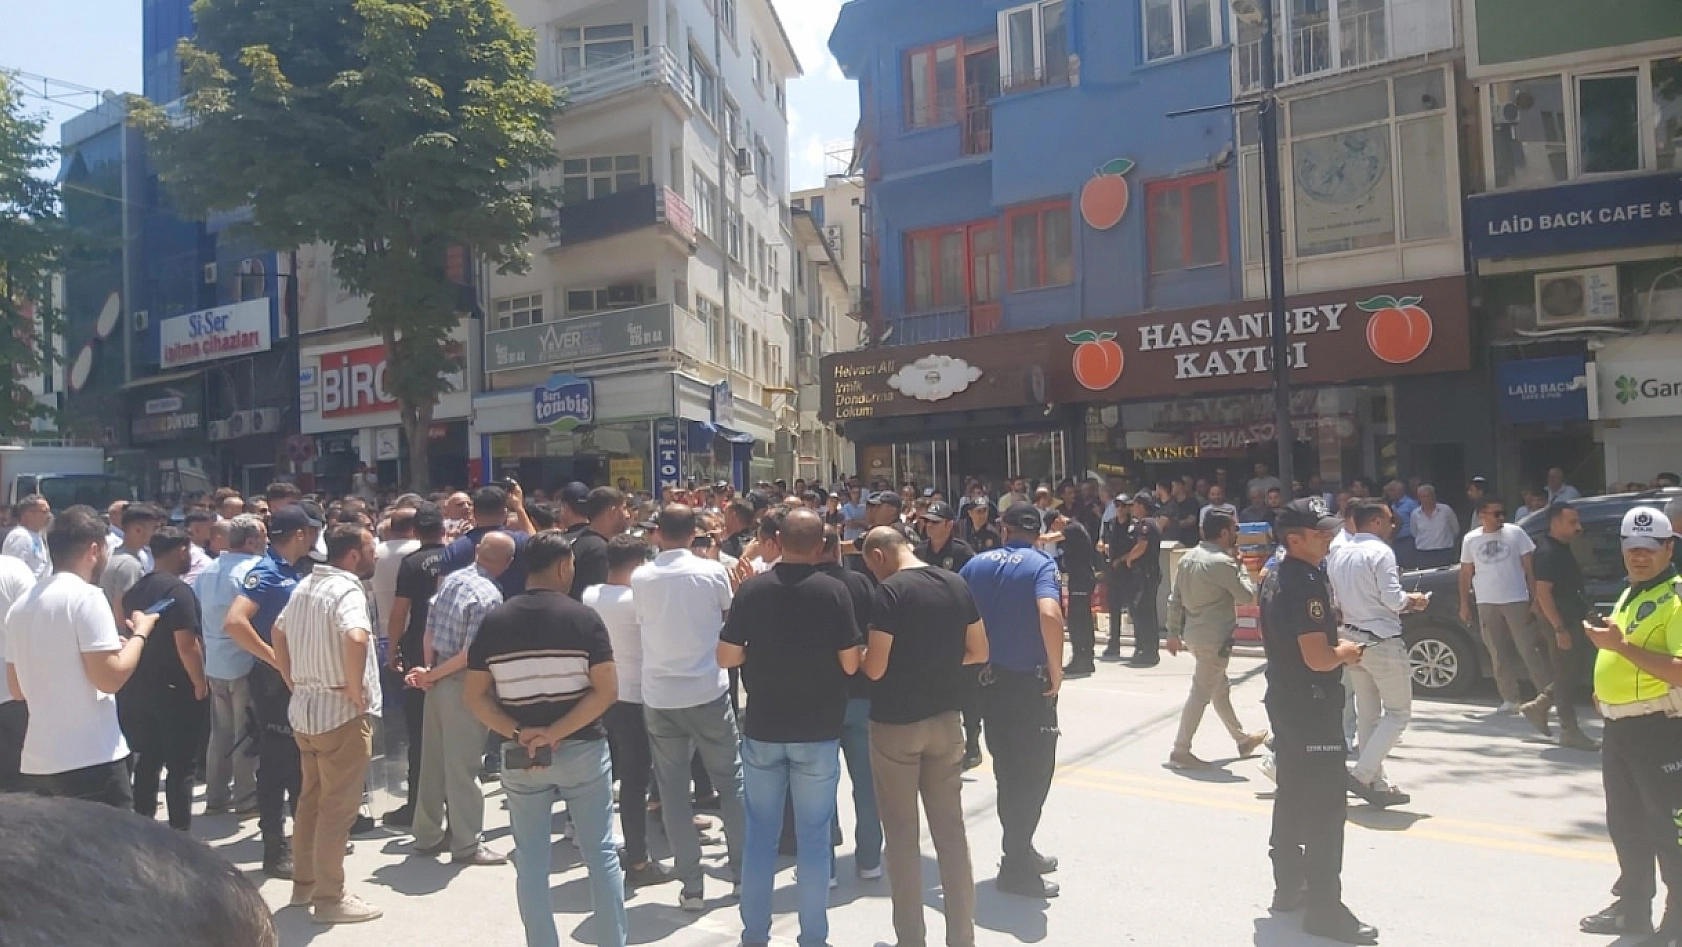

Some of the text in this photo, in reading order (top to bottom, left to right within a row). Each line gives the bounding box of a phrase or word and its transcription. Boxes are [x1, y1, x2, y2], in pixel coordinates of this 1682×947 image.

[1488, 213, 1533, 236] LAİD
[1540, 209, 1594, 230] BACK
[1598, 203, 1653, 223] CAFE
[1658, 202, 1672, 216] &
[1641, 378, 1682, 398] Gar
[536, 393, 589, 420] tombiş
[836, 405, 875, 418] Lokum
